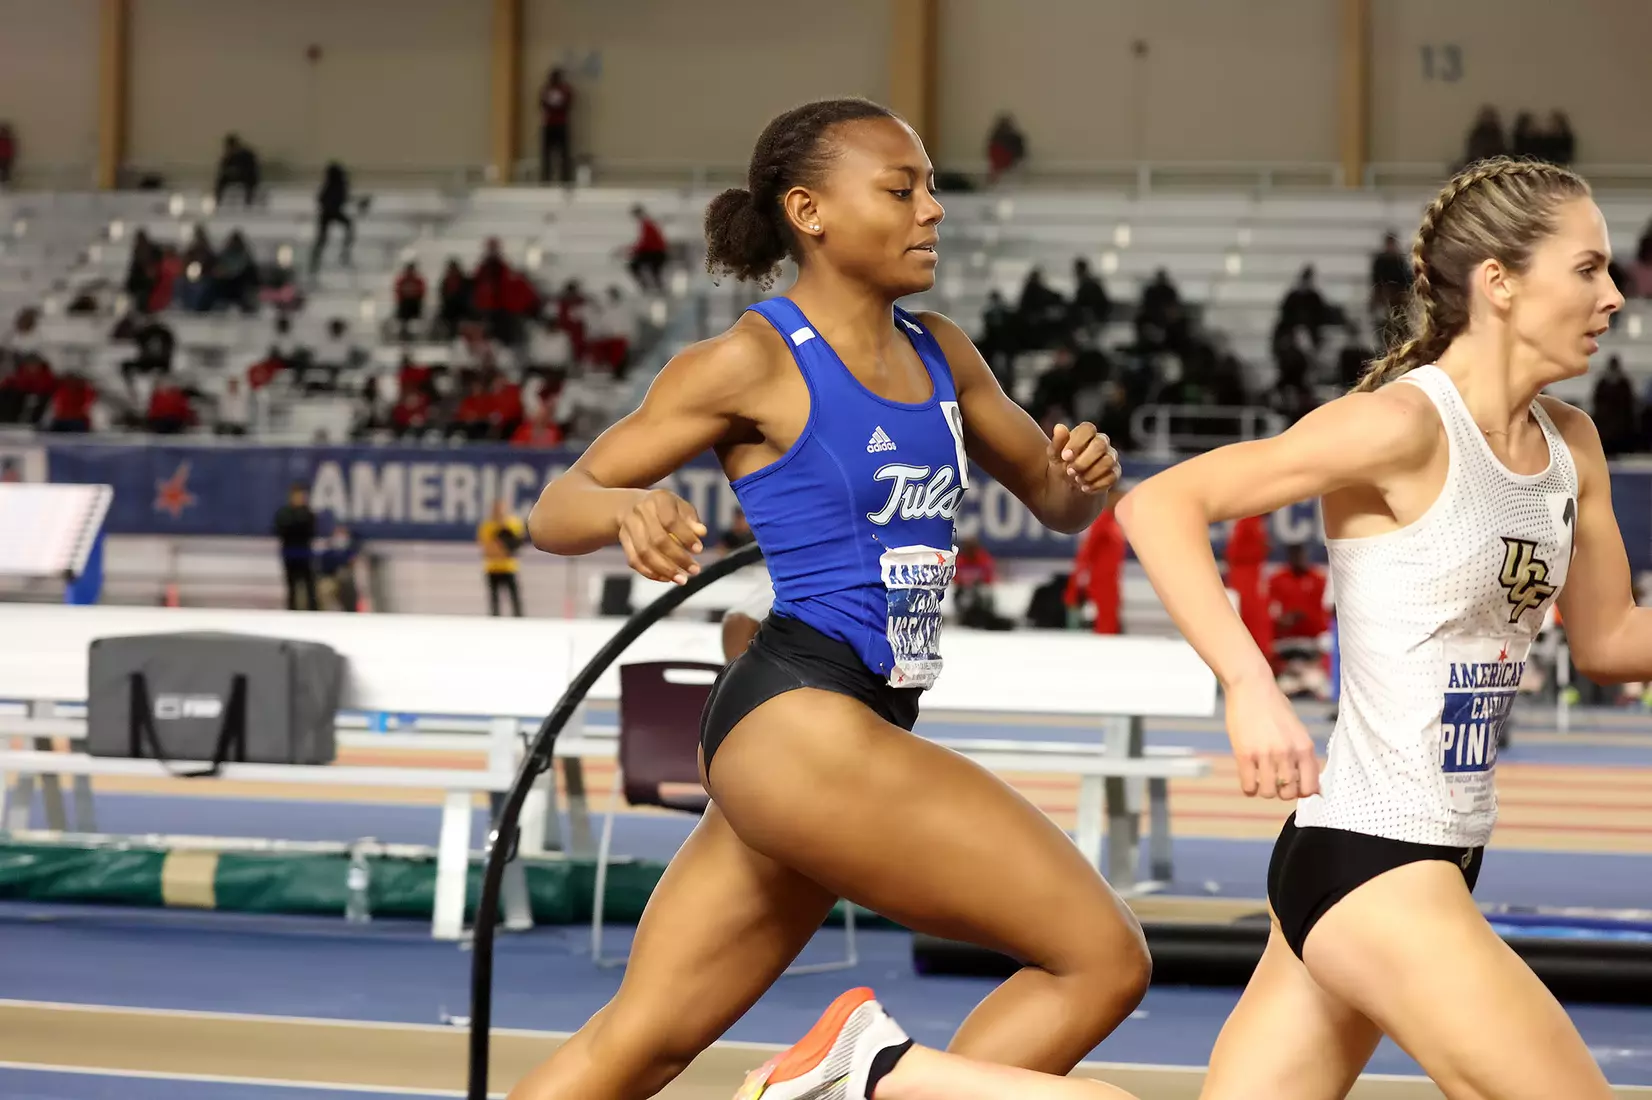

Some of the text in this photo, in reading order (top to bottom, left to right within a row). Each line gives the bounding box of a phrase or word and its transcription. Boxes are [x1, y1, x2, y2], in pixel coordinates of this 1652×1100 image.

[1420, 45, 1463, 82] 13
[866, 441, 897, 454] adidas
[311, 461, 563, 523] AMERIC
[866, 462, 964, 526] Tuls
[1497, 535, 1558, 624] UCF
